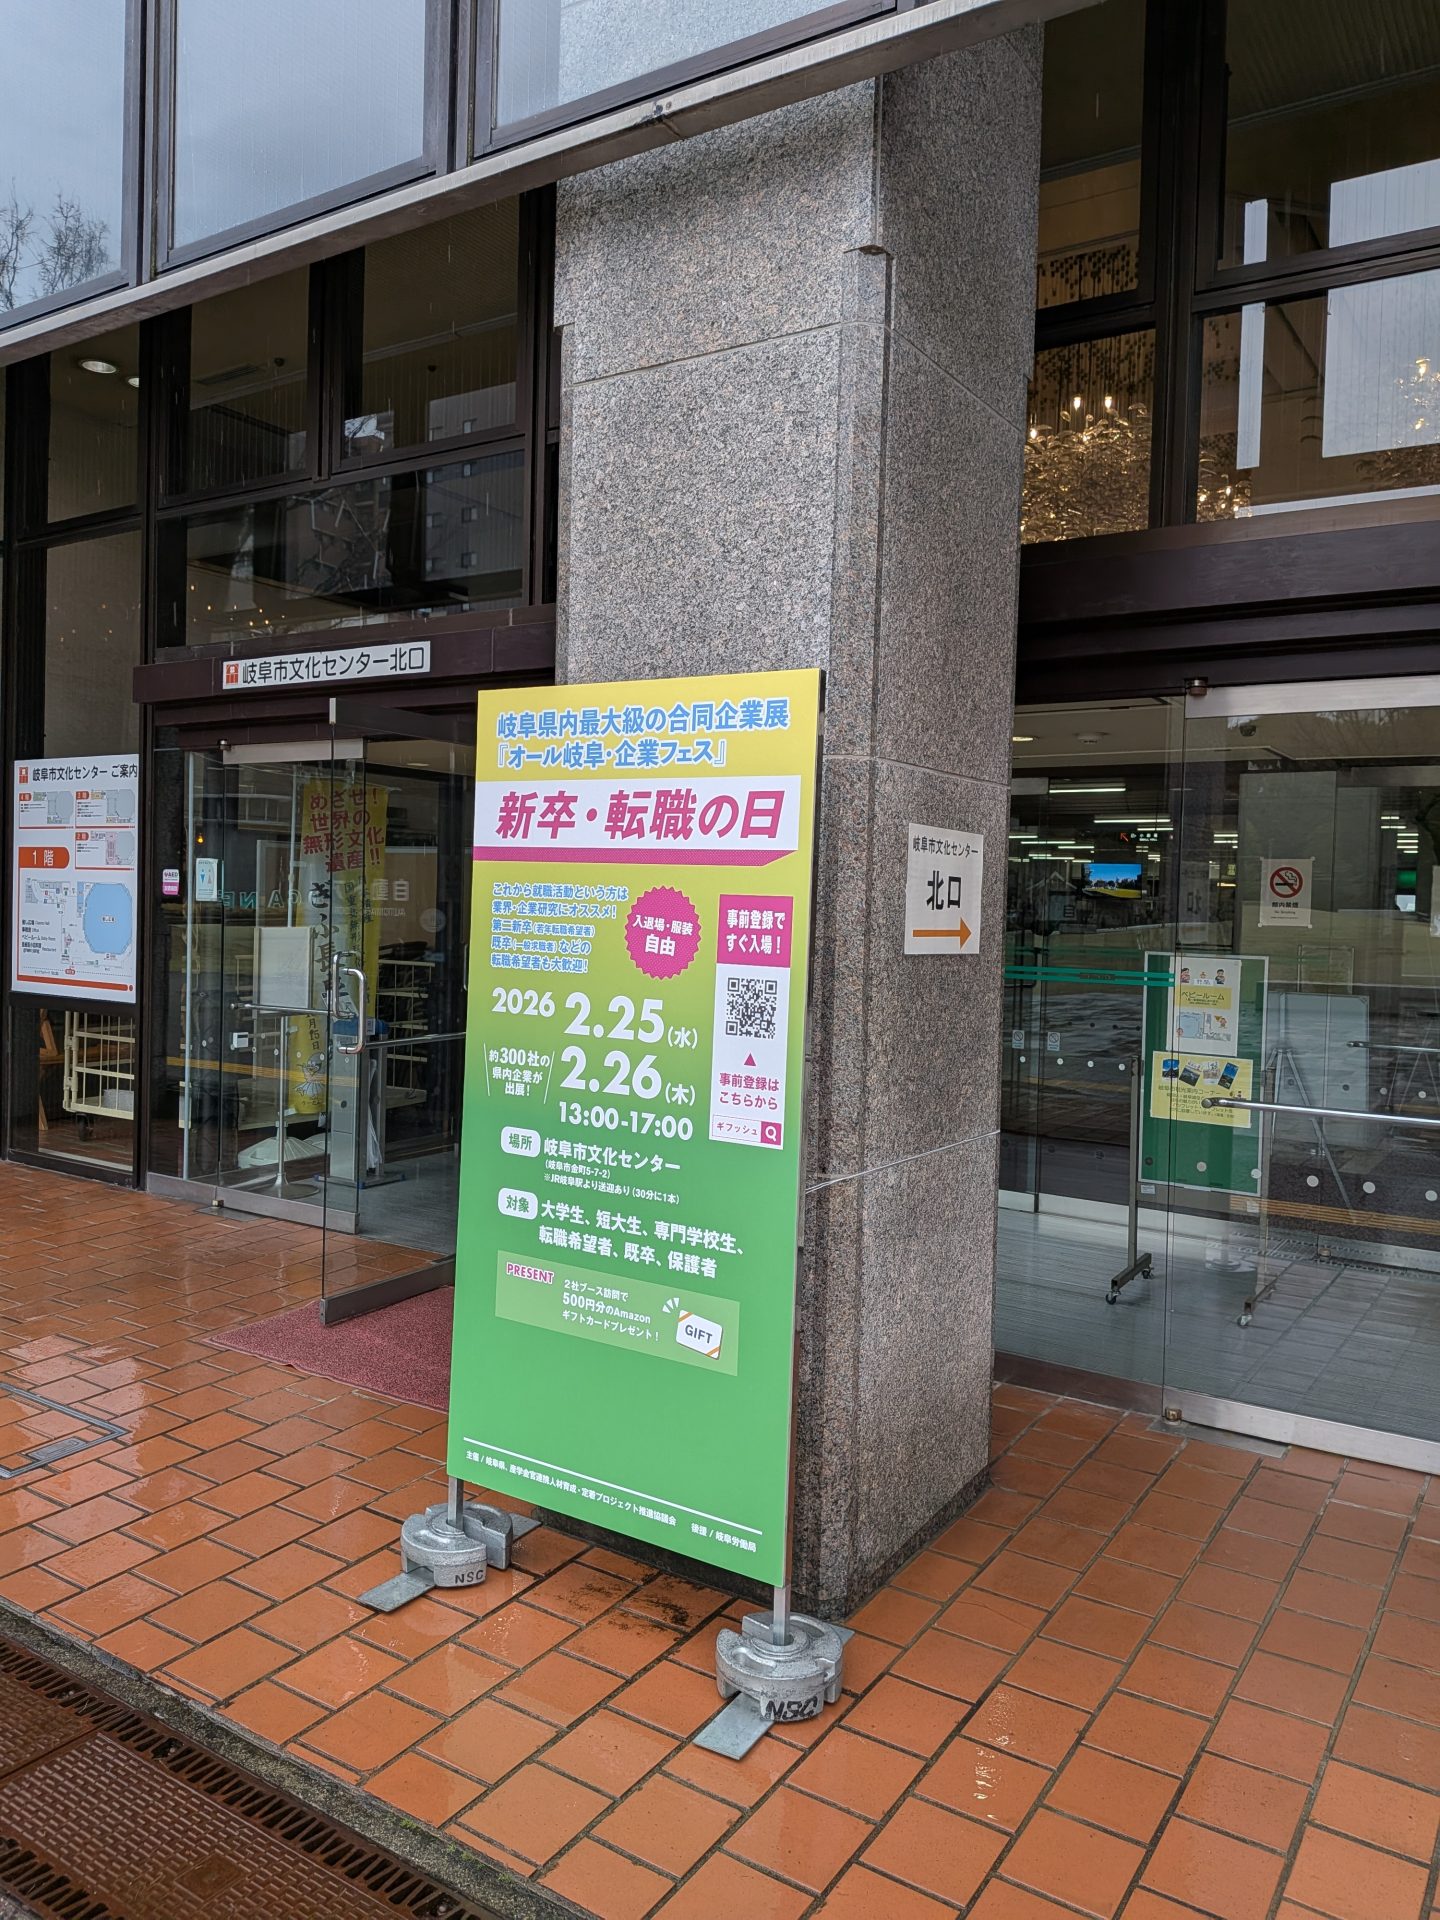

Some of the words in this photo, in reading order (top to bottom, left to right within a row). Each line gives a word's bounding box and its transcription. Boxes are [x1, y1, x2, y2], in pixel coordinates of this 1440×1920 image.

[242, 647, 424, 685] 岐阜市文化センター北口
[497, 698, 789, 739] 岐阜県内最大級の合同企業展
[497, 739, 726, 769] 『オール岐阜・企業フェス』
[32, 765, 108, 782] 岐阜市文化センター
[111, 763, 138, 779] ご案内
[310, 810, 371, 833] 世界の
[495, 788, 785, 841] 新卒・転職の日
[303, 827, 384, 855] 無形文化
[912, 835, 979, 859] 岐阜市文化センター
[32, 849, 54, 866] 1階
[493, 883, 628, 900] これから就職活動という方は
[926, 870, 962, 911] 北口
[492, 900, 617, 919] 業界・企業研究にオススメ！
[727, 909, 785, 930] 事前登録で
[492, 919, 595, 937] 第二新卒(若年転職希望者)
[632, 914, 694, 936] 入退場・服装
[644, 934, 676, 957] 自由
[726, 933, 781, 955] すぐ入場！
[491, 954, 588, 973] 転職希望者も大歓迎！
[491, 987, 556, 1018] 2026
[488, 1047, 551, 1067] 約300社の
[492, 1066, 543, 1084] 県内企業が
[719, 1072, 780, 1092] 事前登録は
[504, 1082, 530, 1096] 出展！
[719, 1091, 778, 1110] こちらから
[558, 1101, 694, 1141] 13:00-17:00
[716, 1122, 758, 1136] ギフッシュ
[508, 1132, 533, 1151] 場所
[543, 1137, 680, 1174] 岐阜市文化センター
[545, 1159, 611, 1179] (岐阜市金町5-7-2)
[505, 1194, 530, 1213] 対象
[538, 1225, 718, 1279] 転職希望者、既卒、保護者
[506, 1262, 555, 1284] PRESENT
[564, 1279, 629, 1303] 2社ブース訪問で
[562, 1291, 651, 1325] 500円分のAmazon
[562, 1309, 660, 1342] ギフトカードプレゼント！
[684, 1324, 713, 1345] GIFT
[454, 1569, 484, 1584] NSC
[765, 1695, 818, 1720] NSC
